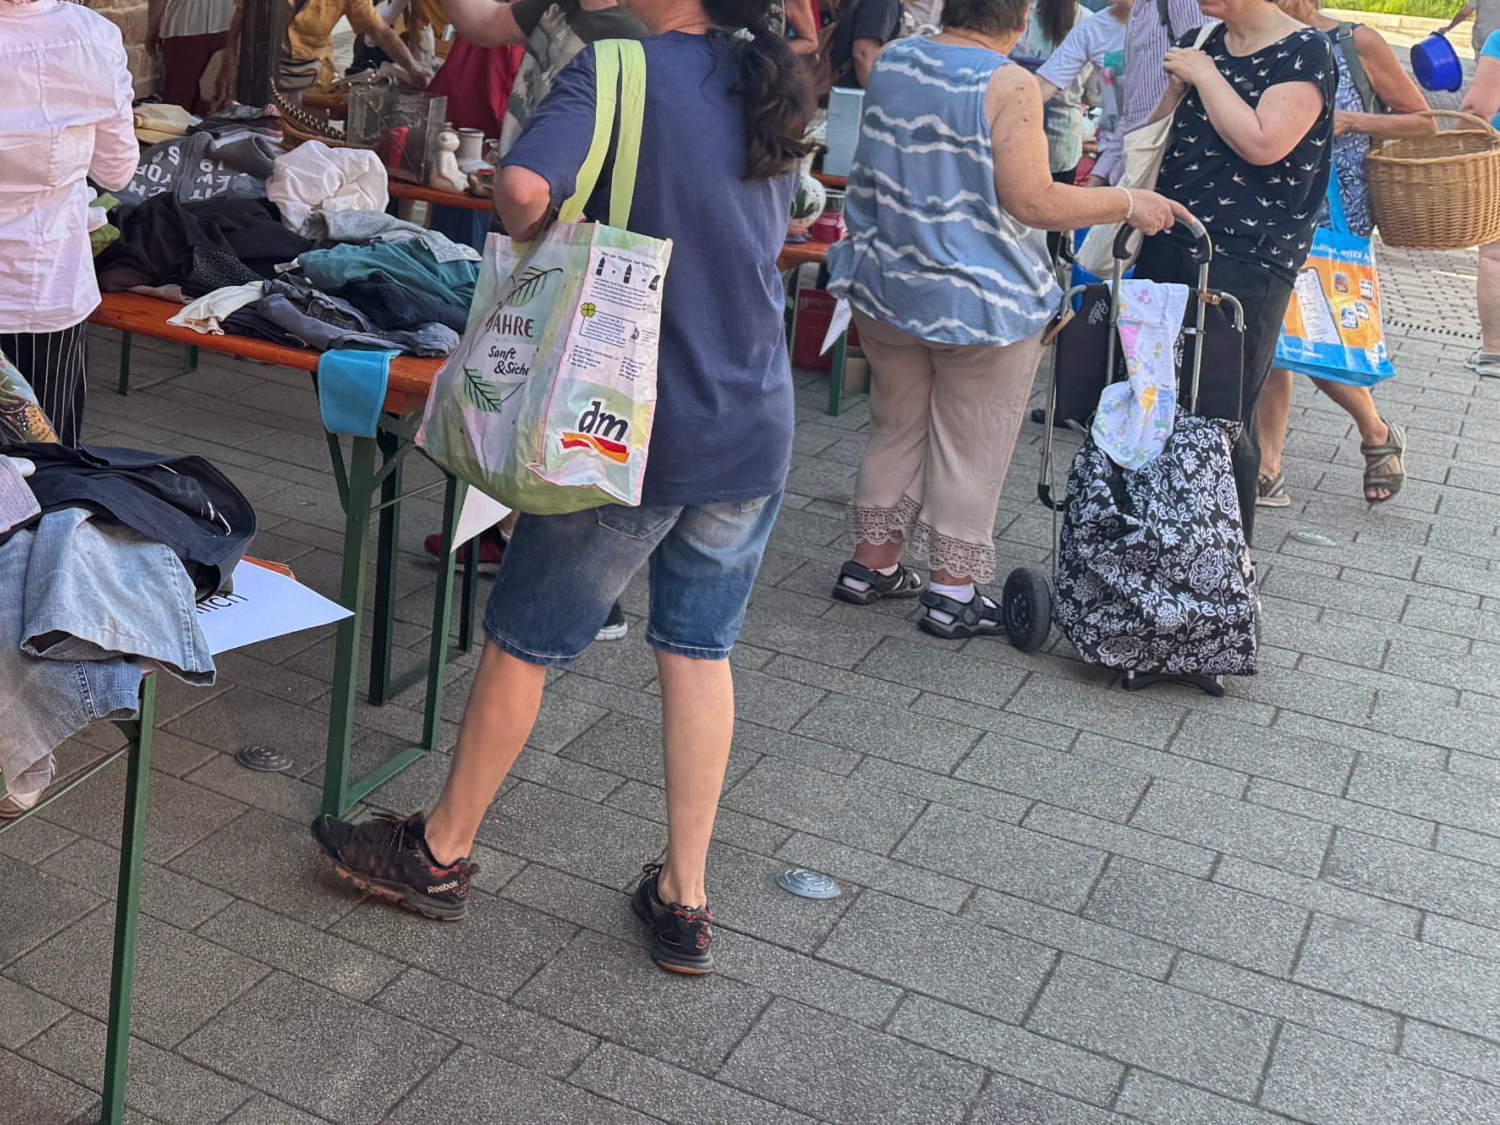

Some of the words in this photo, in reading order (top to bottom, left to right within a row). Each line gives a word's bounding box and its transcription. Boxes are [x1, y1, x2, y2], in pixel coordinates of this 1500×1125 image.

[485, 306, 535, 338] JAHRE
[488, 345, 516, 362] Sanft
[578, 400, 629, 442] dm
[427, 879, 459, 894] Reebok
